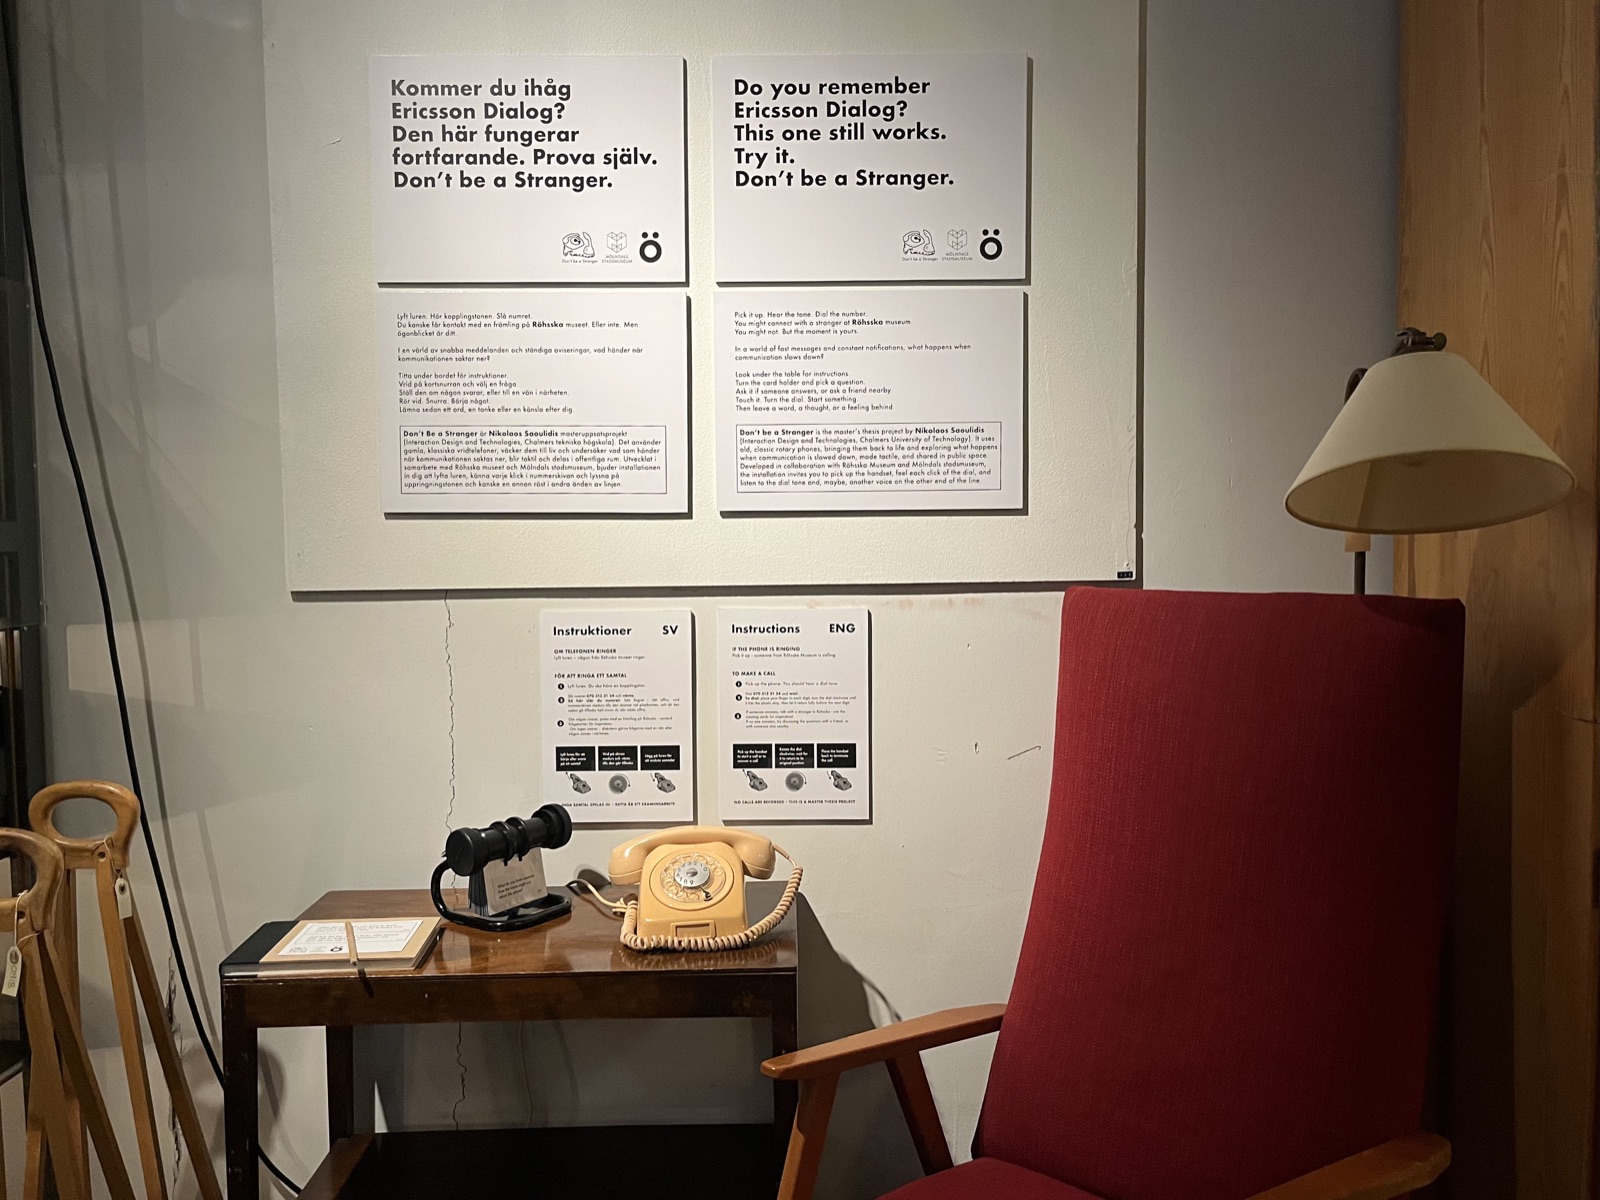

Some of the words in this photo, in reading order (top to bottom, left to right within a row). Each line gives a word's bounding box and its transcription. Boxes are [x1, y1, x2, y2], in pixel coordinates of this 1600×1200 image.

[391, 80, 482, 96] Kommer
[490, 78, 516, 96] du
[525, 78, 570, 100] ihåg
[735, 79, 762, 95] Do
[771, 84, 810, 100] you
[819, 77, 930, 94] remember
[392, 102, 475, 119] Ericsson
[484, 101, 565, 124] Dialog?
[735, 101, 817, 118] Ericsson
[827, 100, 907, 122] Dialog?
[393, 126, 433, 141] Den
[442, 124, 477, 141] här
[485, 124, 579, 146] fungerar
[734, 123, 774, 141] This
[782, 129, 821, 140] one
[829, 123, 864, 140] still
[872, 122, 946, 139] works.
[393, 147, 524, 164] fortfarande.
[534, 149, 594, 164] Prova
[603, 147, 657, 169] själv.
[734, 148, 768, 169] Try
[776, 147, 794, 163] it.
[394, 172, 452, 187] Don’t
[460, 170, 485, 187] be
[494, 177, 506, 187] a
[515, 171, 612, 192] Stranger.
[736, 170, 793, 186] Don’t
[801, 169, 826, 186] be
[835, 175, 847, 186] a
[856, 169, 954, 190] Stranger.
[554, 625, 631, 635] Instruktioner
[663, 625, 678, 635] SV
[732, 624, 800, 633] Instructions
[830, 624, 855, 633] ENG
